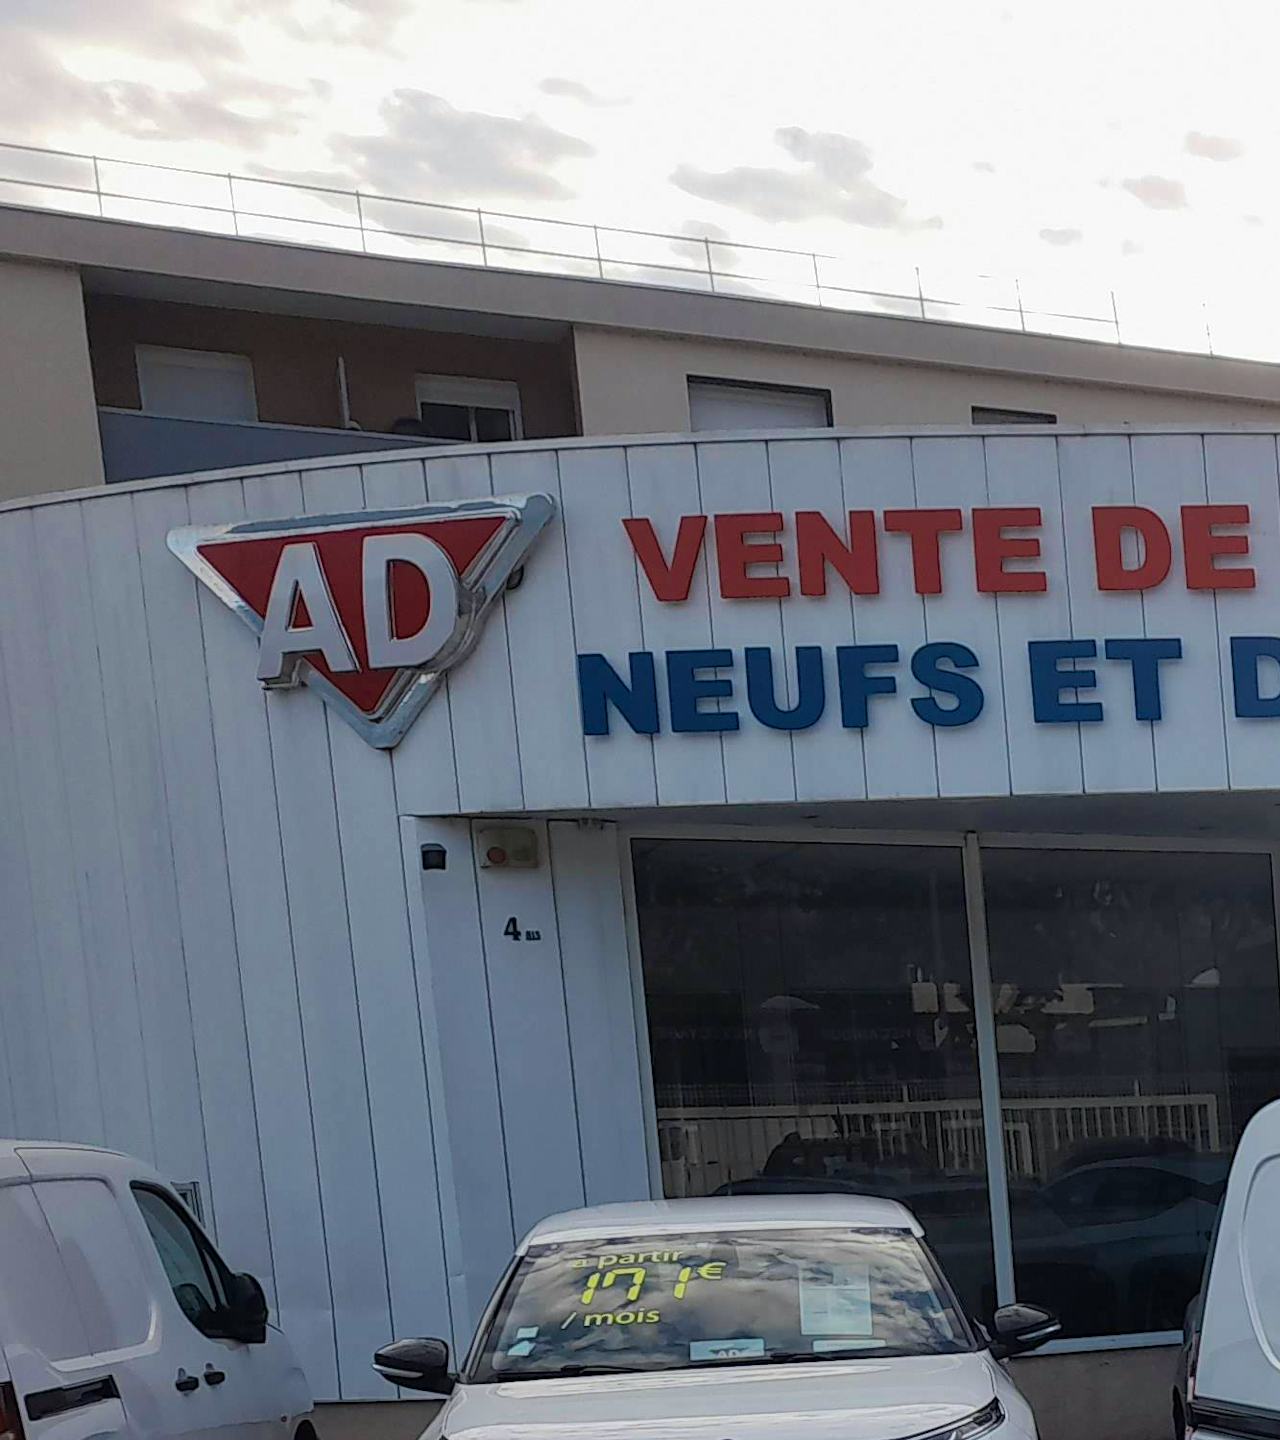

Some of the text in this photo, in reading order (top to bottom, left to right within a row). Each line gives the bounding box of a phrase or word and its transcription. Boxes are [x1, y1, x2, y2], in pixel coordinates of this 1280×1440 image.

[622, 507, 1048, 601] VENTE
[1092, 504, 1257, 592] DE
[257, 532, 462, 686] AD
[577, 641, 985, 736] NEUFS
[1028, 637, 1182, 723] ET
[504, 916, 521, 941] 4
[598, 1249, 684, 1269] partir
[584, 1308, 660, 1327] mois
